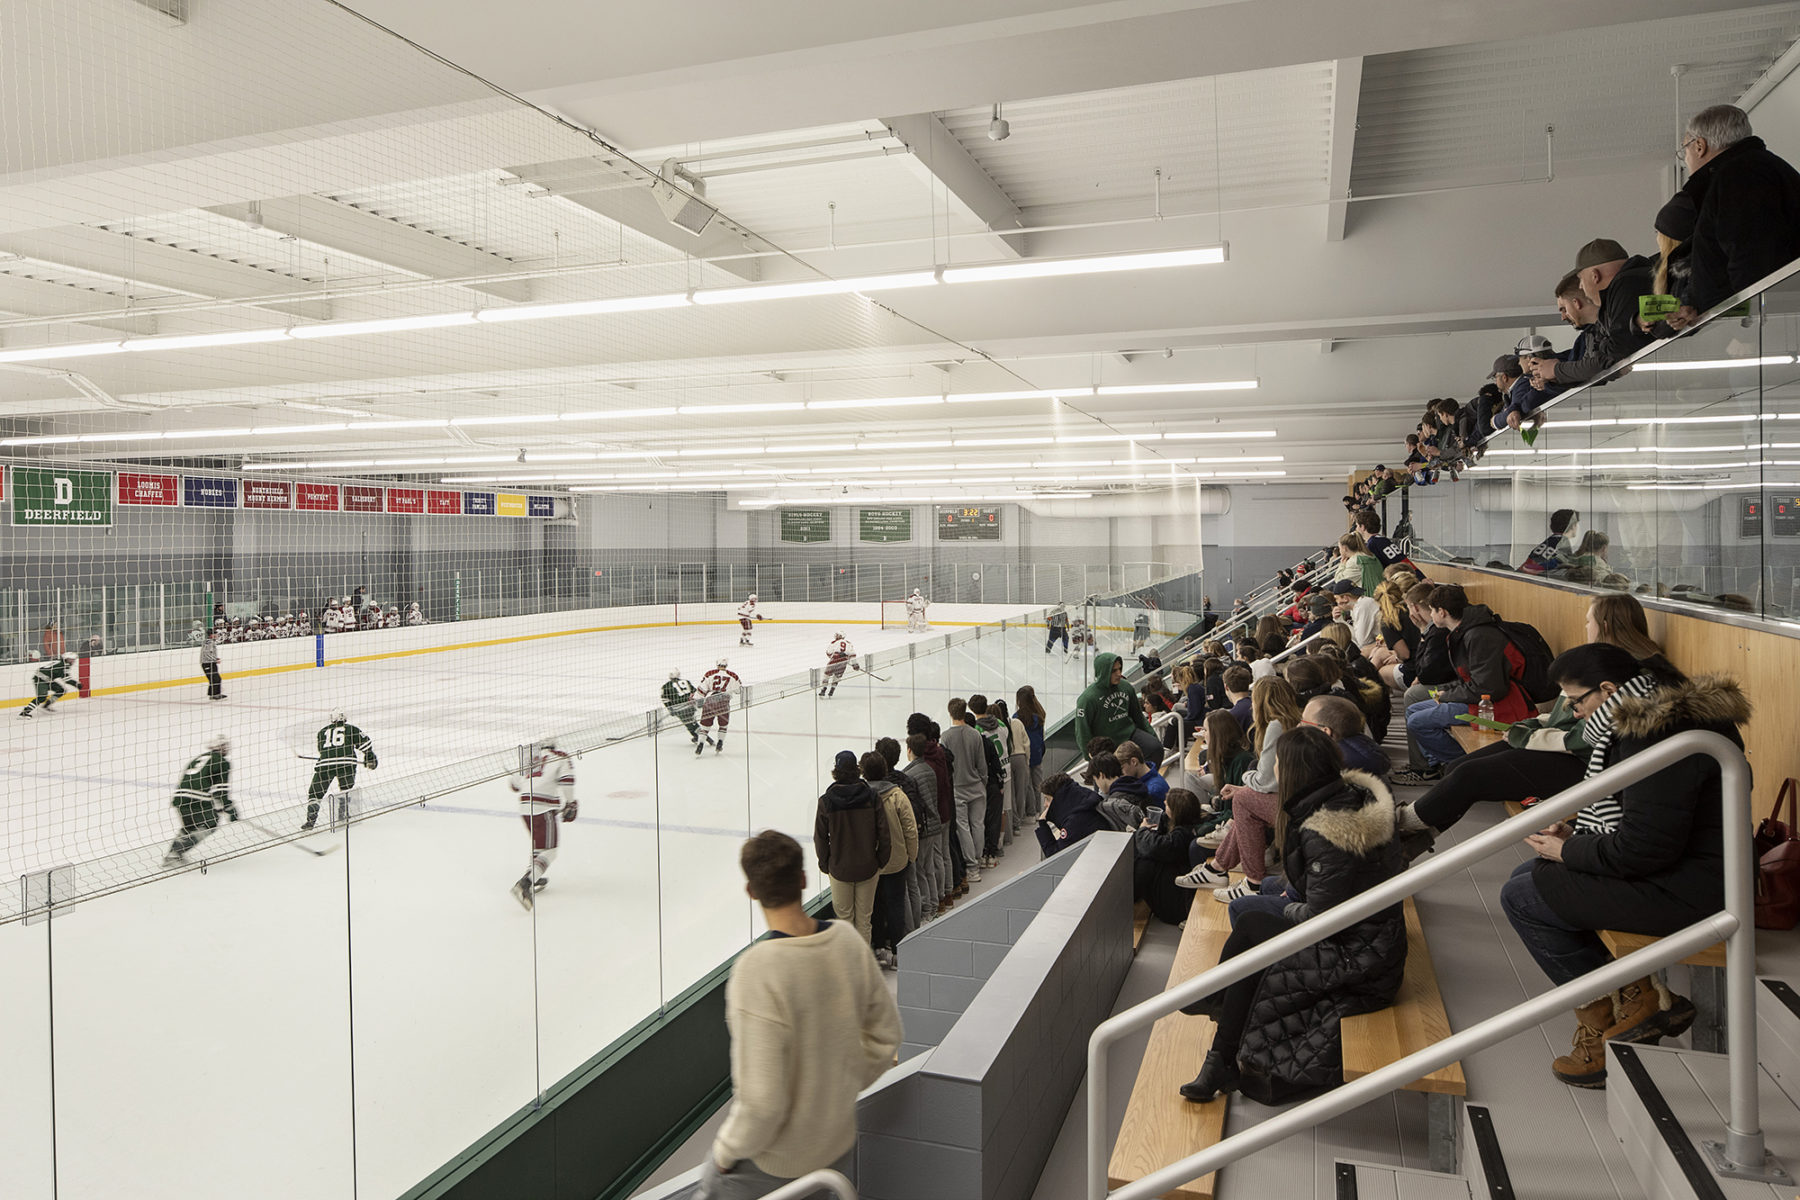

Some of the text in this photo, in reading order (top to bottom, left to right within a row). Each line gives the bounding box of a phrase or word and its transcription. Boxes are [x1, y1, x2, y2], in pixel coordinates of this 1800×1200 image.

[137, 480, 160, 489] LOOMIS
[54, 478, 73, 505] D
[135, 490, 163, 498] CHAFFEE
[24, 509, 101, 520] DEERFIELD
[963, 508, 978, 516] 3:22
[947, 514, 952, 522] 0
[989, 514, 994, 522] 0
[1383, 544, 1401, 560] 88
[840, 641, 846, 652] 9
[672, 680, 691, 696] 19
[712, 675, 730, 692] 27
[1103, 691, 1129, 709] DEERFIELD
[323, 727, 345, 748] 16
